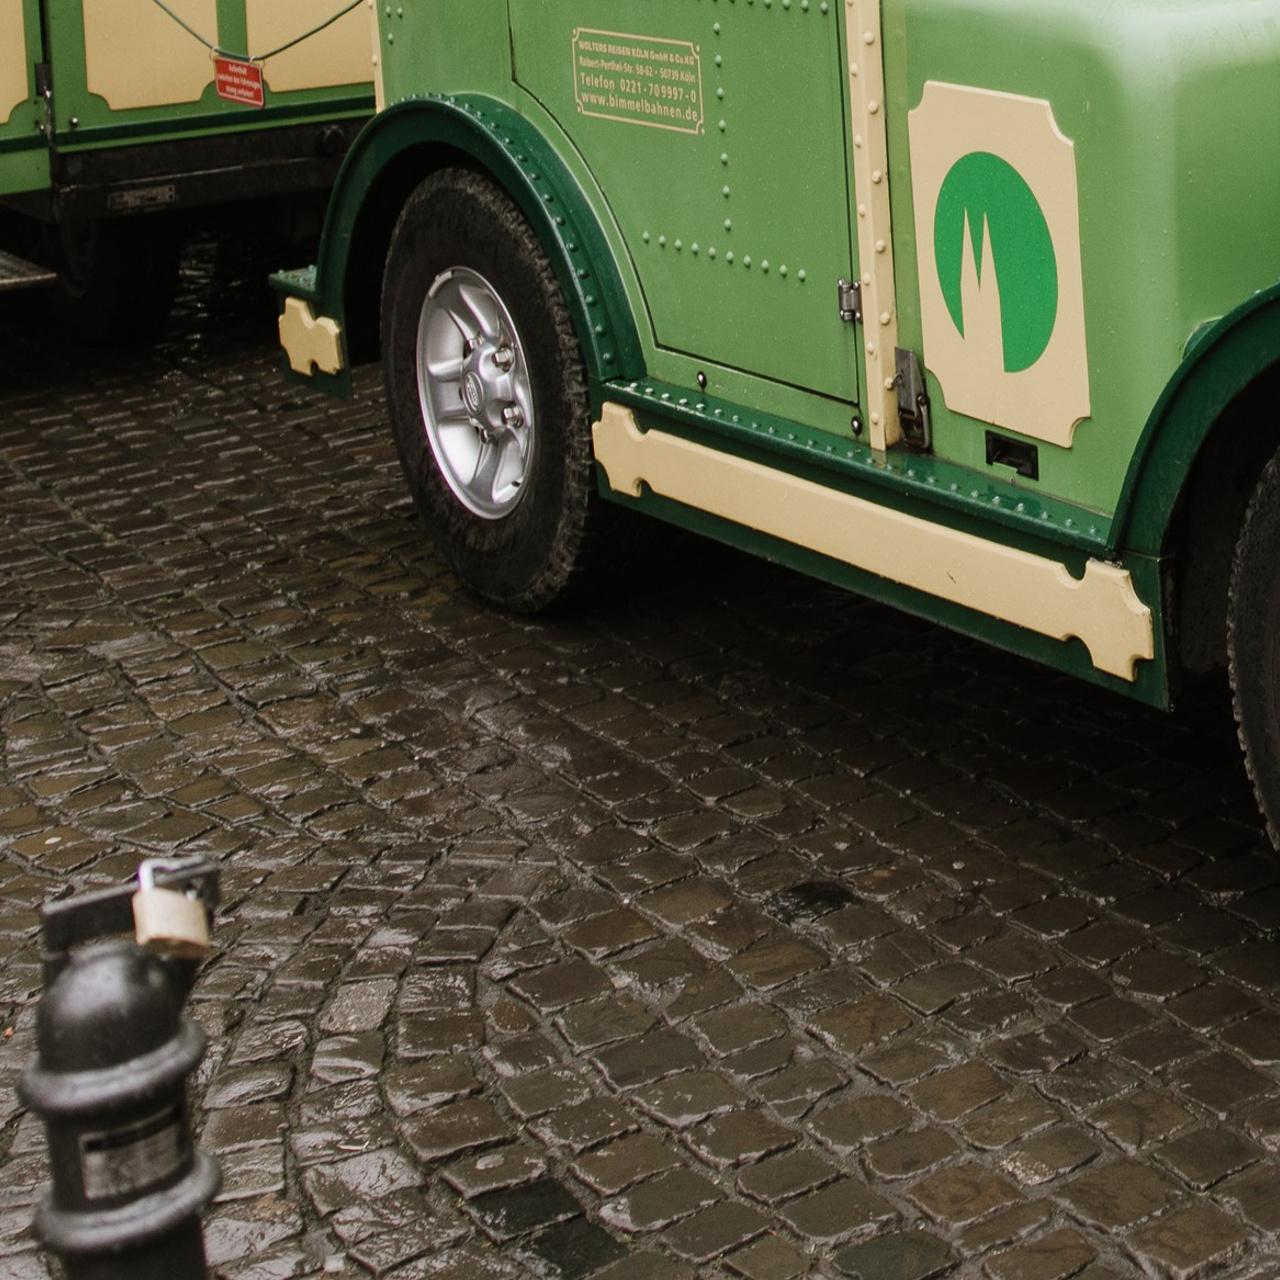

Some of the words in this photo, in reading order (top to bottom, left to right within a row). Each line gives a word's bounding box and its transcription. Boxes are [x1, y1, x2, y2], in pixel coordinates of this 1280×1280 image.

[631, 47, 649, 59] KÖLN
[650, 50, 668, 62] GmbH
[581, 72, 615, 90] Telefon
[680, 71, 696, 83] Köln
[581, 92, 698, 122] www.bimmelbahnen.de
